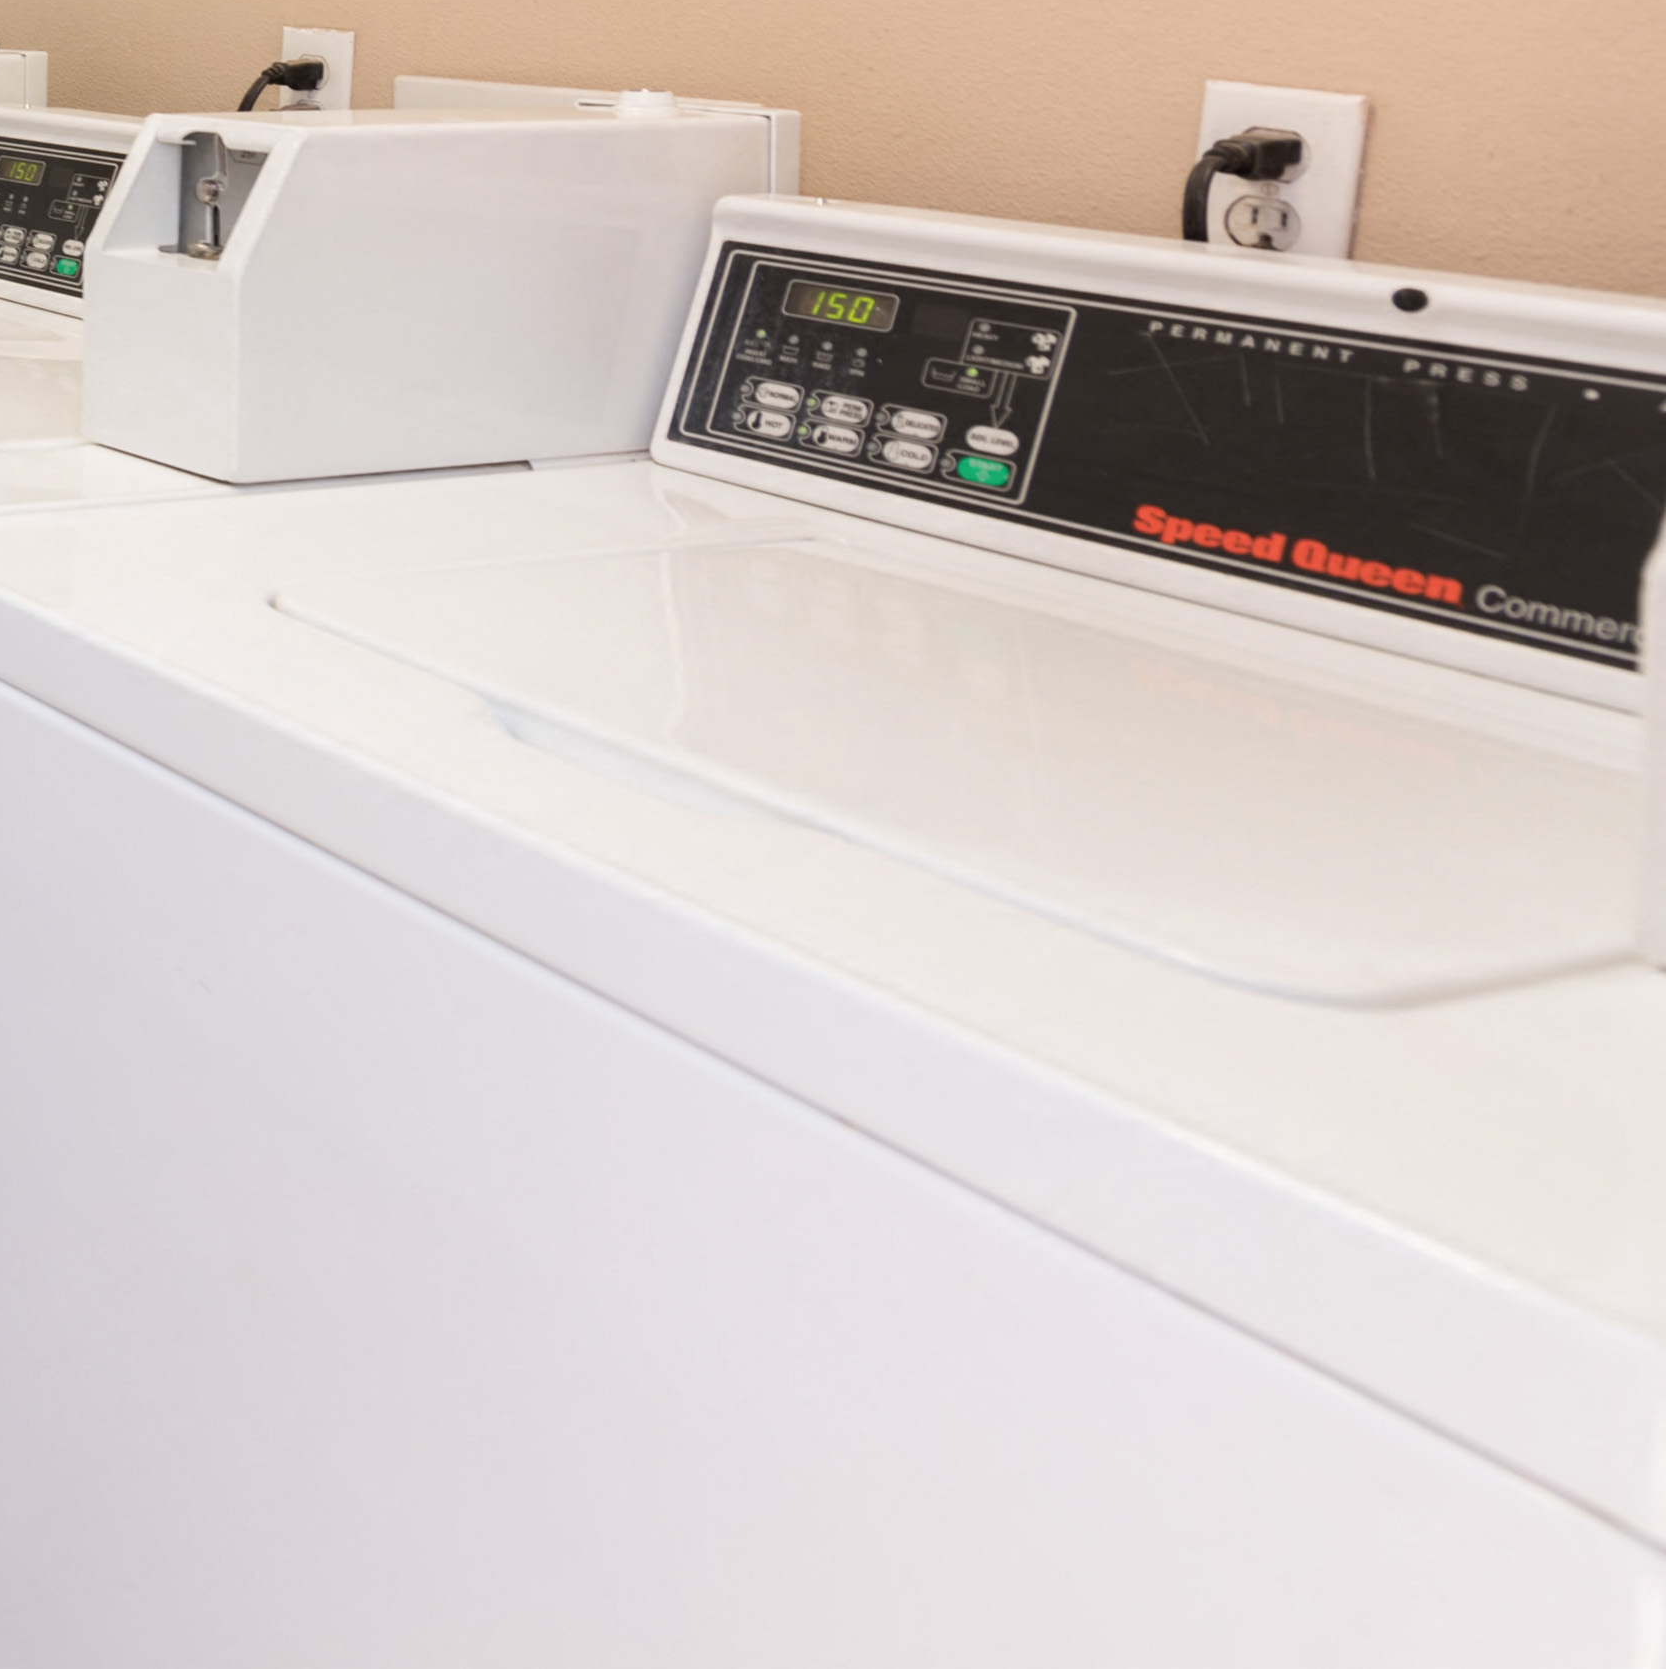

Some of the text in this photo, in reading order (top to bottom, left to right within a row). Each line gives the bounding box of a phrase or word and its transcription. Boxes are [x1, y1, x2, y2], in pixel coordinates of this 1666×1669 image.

[9, 161, 38, 182] 150
[812, 291, 875, 323] 150
[1149, 320, 1530, 392] PERMANENT PRESS
[768, 390, 797, 403] NORMAL
[843, 403, 864, 411] PERM
[840, 409, 862, 420] PRESS
[765, 419, 783, 428] HOT
[827, 434, 858, 445] WARM
[991, 436, 1014, 447] LEVEL
[900, 450, 928, 461] COLD
[968, 459, 1003, 472] START
[1133, 504, 1287, 563] Speed
[1291, 539, 1464, 605] Queen
